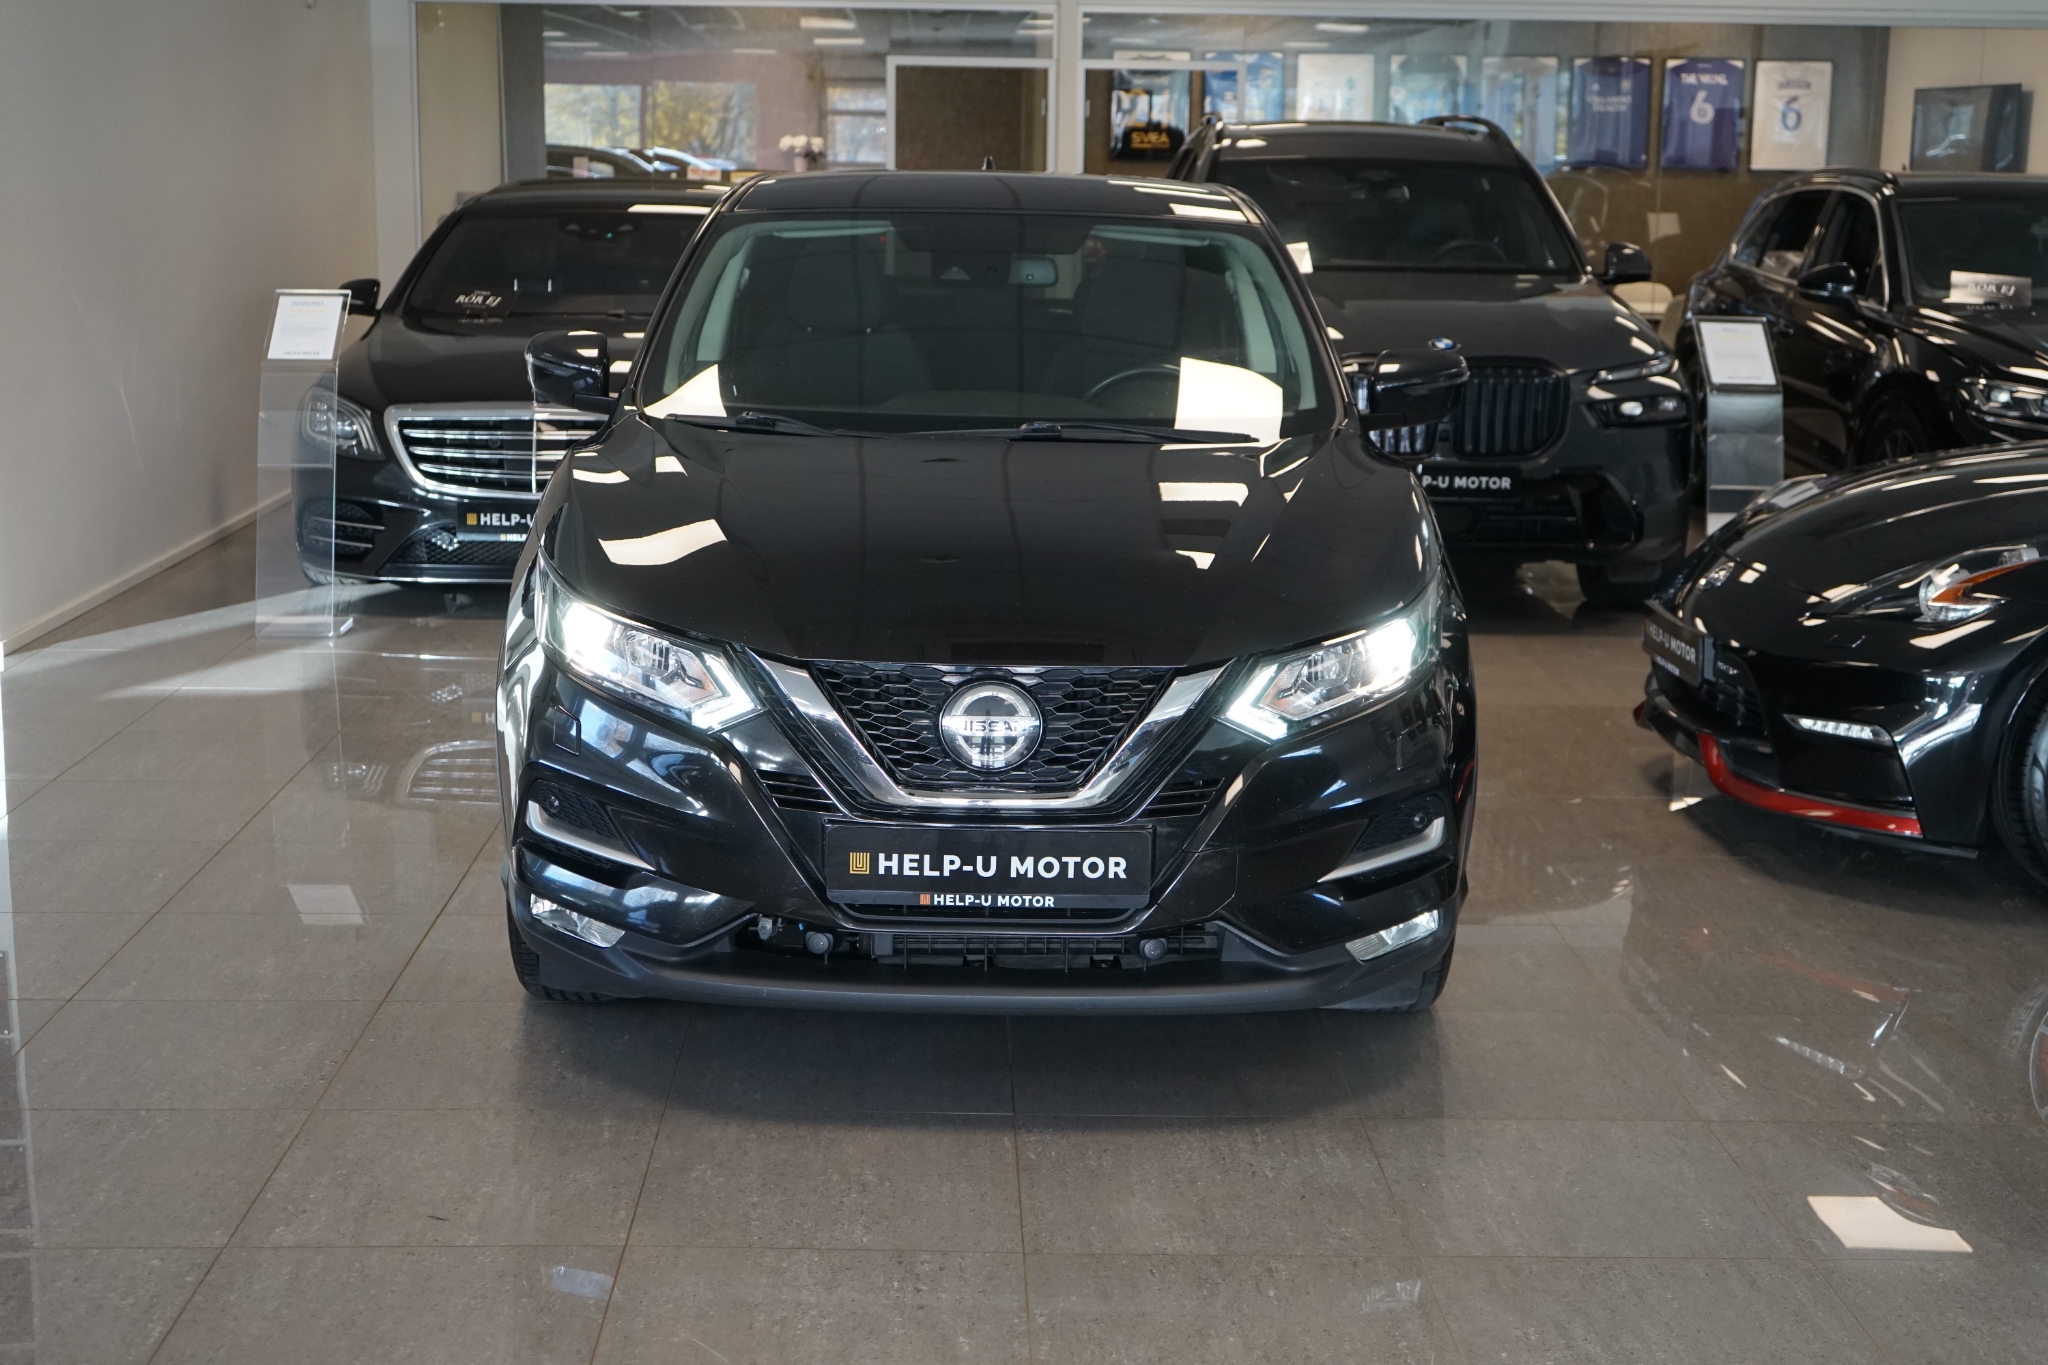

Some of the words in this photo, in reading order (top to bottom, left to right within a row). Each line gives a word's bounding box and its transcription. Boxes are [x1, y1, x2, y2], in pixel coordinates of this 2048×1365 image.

[1690, 90, 1715, 124] 6
[1781, 95, 1803, 132] 6
[1422, 475, 1450, 488] P-U
[1454, 476, 1512, 490] MOTOR
[506, 533, 527, 541] HELP
[1670, 636, 1696, 664] MOTOR
[878, 853, 997, 878] HELP-U
[1010, 856, 1127, 879] MOTOR
[933, 893, 992, 907] HELP-U
[997, 895, 1055, 908] MOTOR
